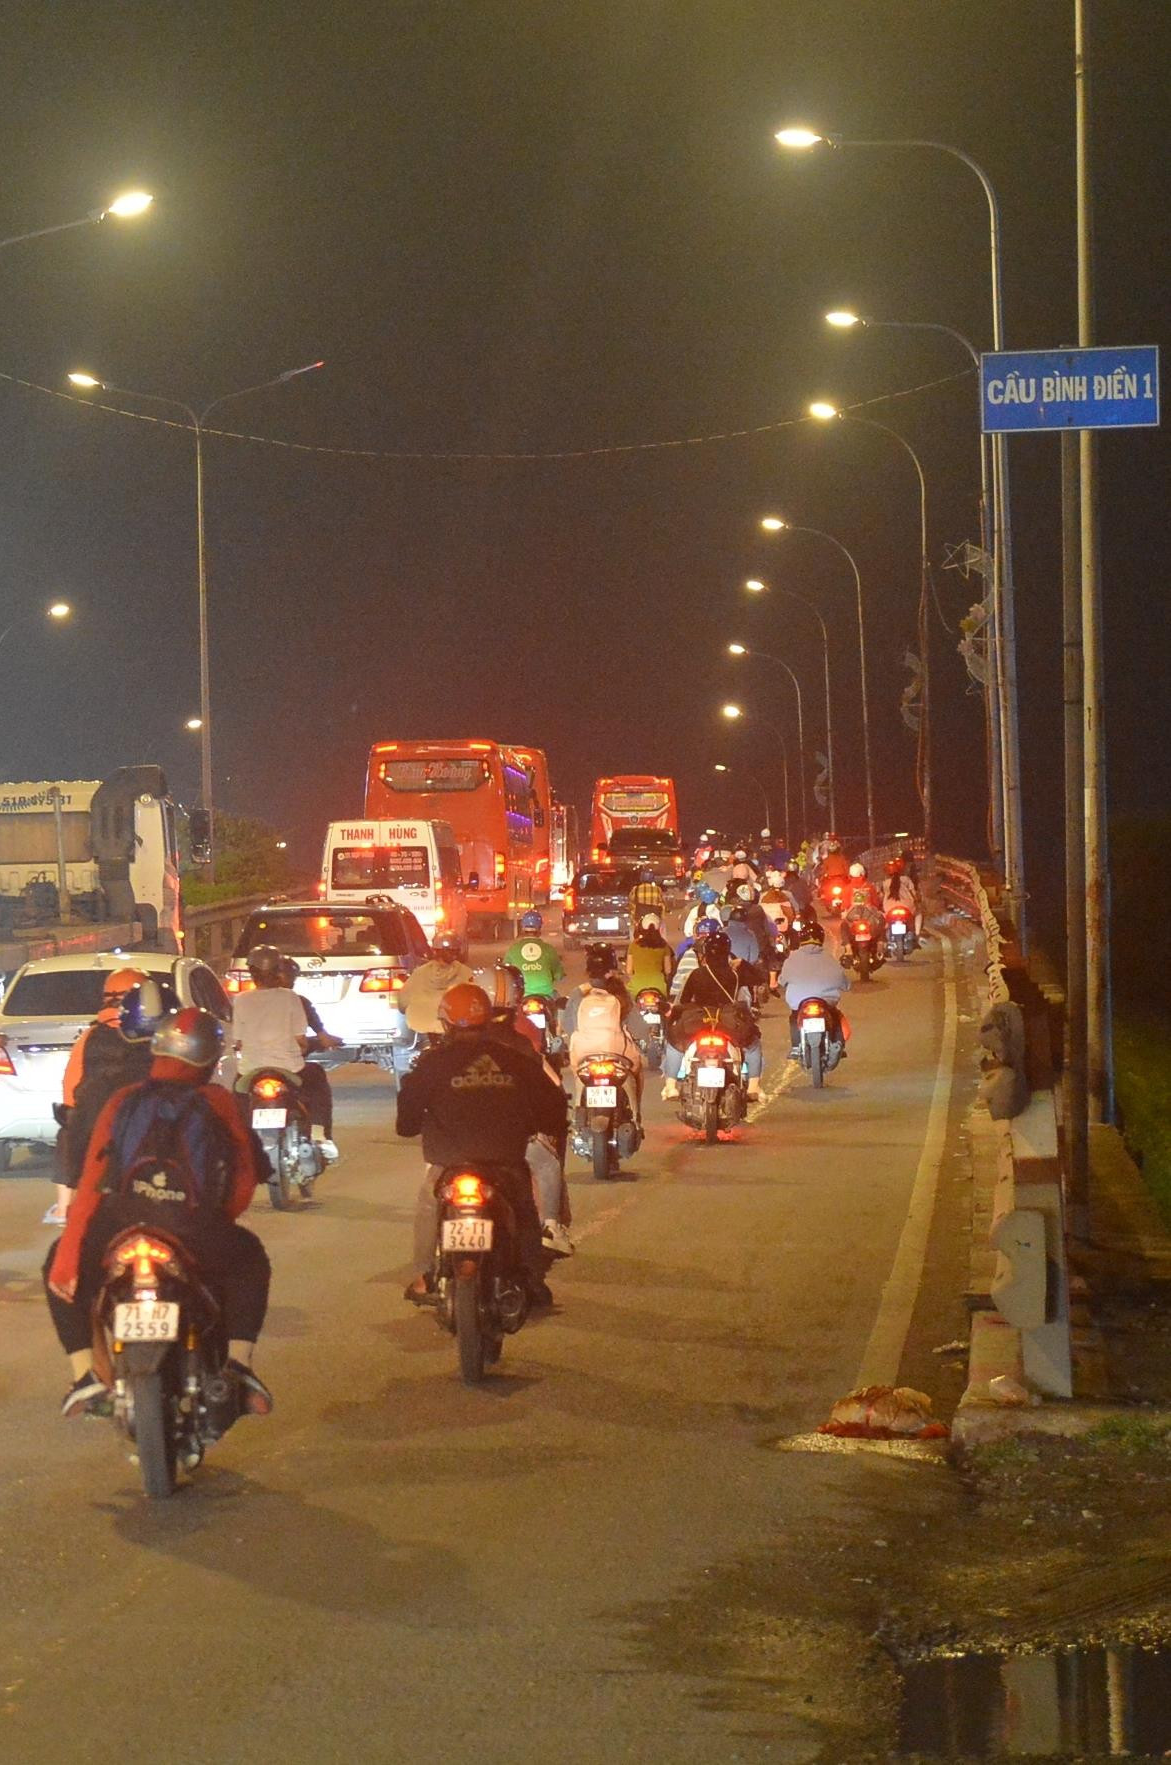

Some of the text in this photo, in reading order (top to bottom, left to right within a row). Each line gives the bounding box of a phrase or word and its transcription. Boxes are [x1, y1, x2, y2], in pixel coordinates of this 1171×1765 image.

[987, 365, 1153, 404] CẦU BÌNH ĐIỀN 1
[340, 824, 418, 841] THANH HÙNG
[521, 962, 542, 971] Grab
[451, 1071, 515, 1088] adidas
[449, 1235, 486, 1249] 3440
[124, 1321, 169, 1337] 2559
